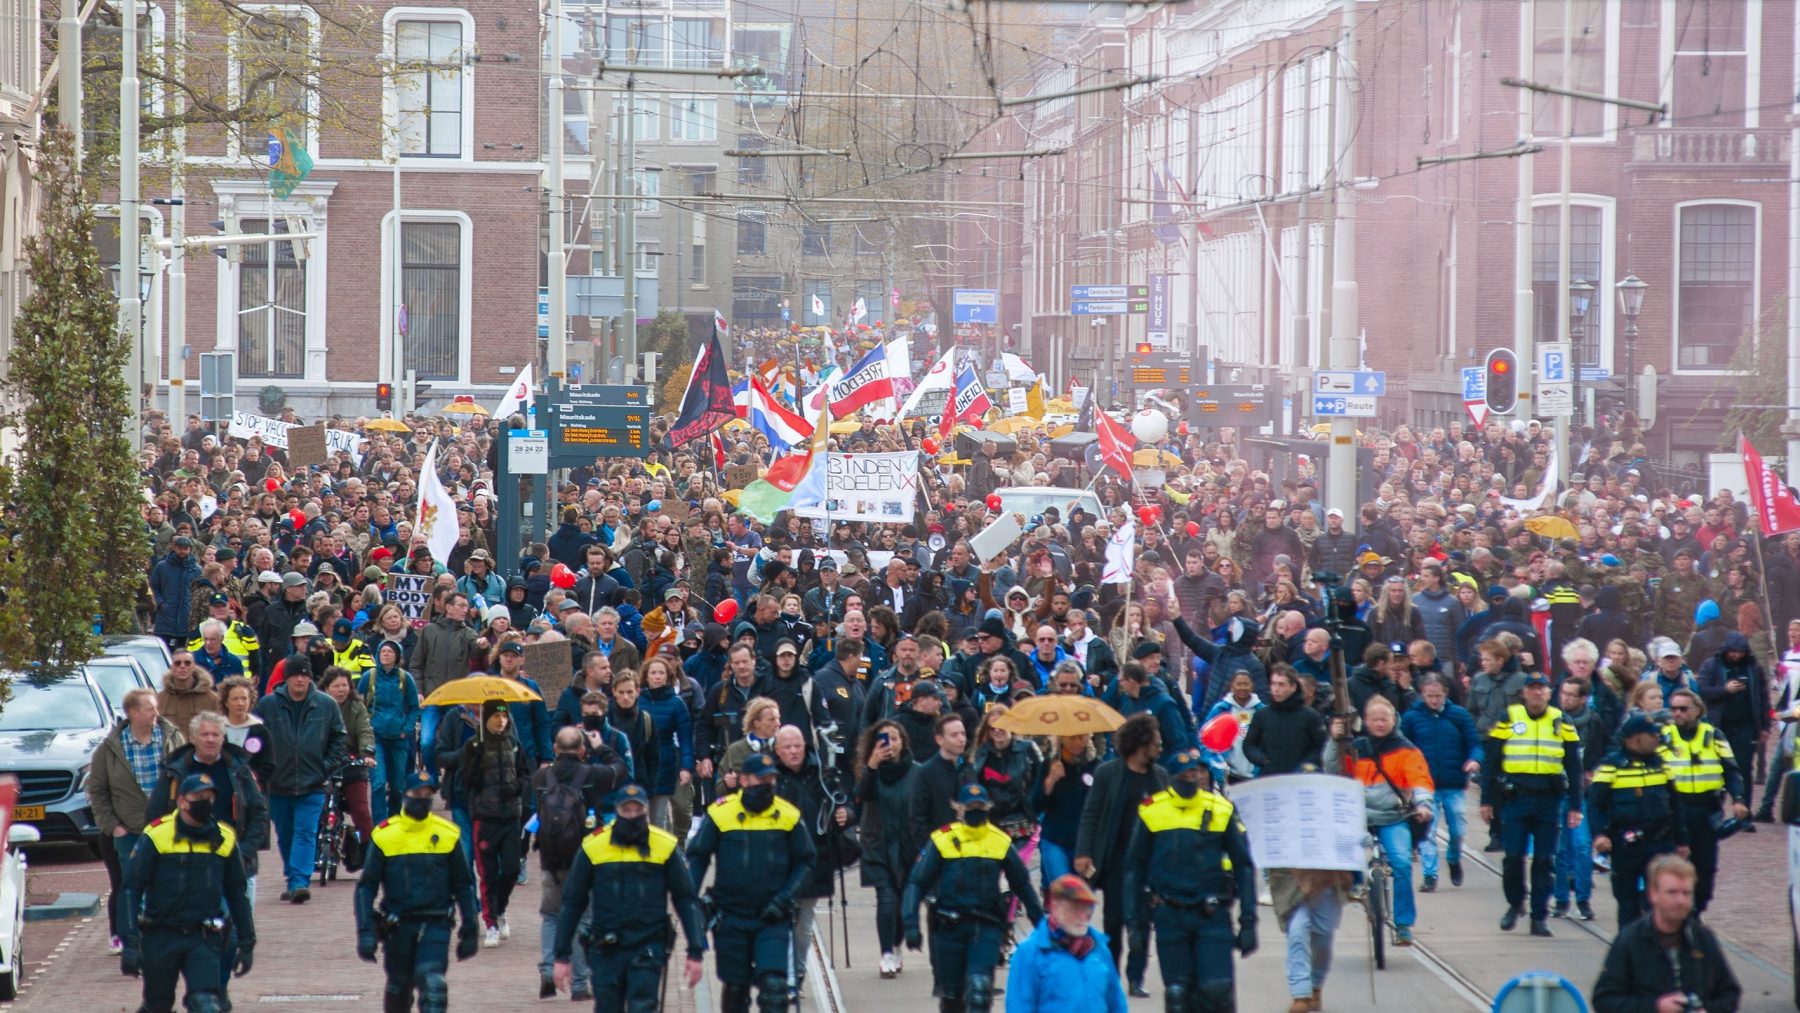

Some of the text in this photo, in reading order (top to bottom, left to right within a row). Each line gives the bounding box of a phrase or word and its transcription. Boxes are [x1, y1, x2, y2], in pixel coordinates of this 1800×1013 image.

[1155, 276, 1163, 326] TE HUUR
[1320, 376, 1330, 389] P
[1347, 402, 1374, 410] Route
[236, 412, 260, 430] STOP
[828, 457, 902, 475] BINDEN
[395, 577, 426, 591] MY
[388, 591, 431, 603] BODY
[397, 604, 426, 618] MY
[15, 808, 38, 818] N-21
